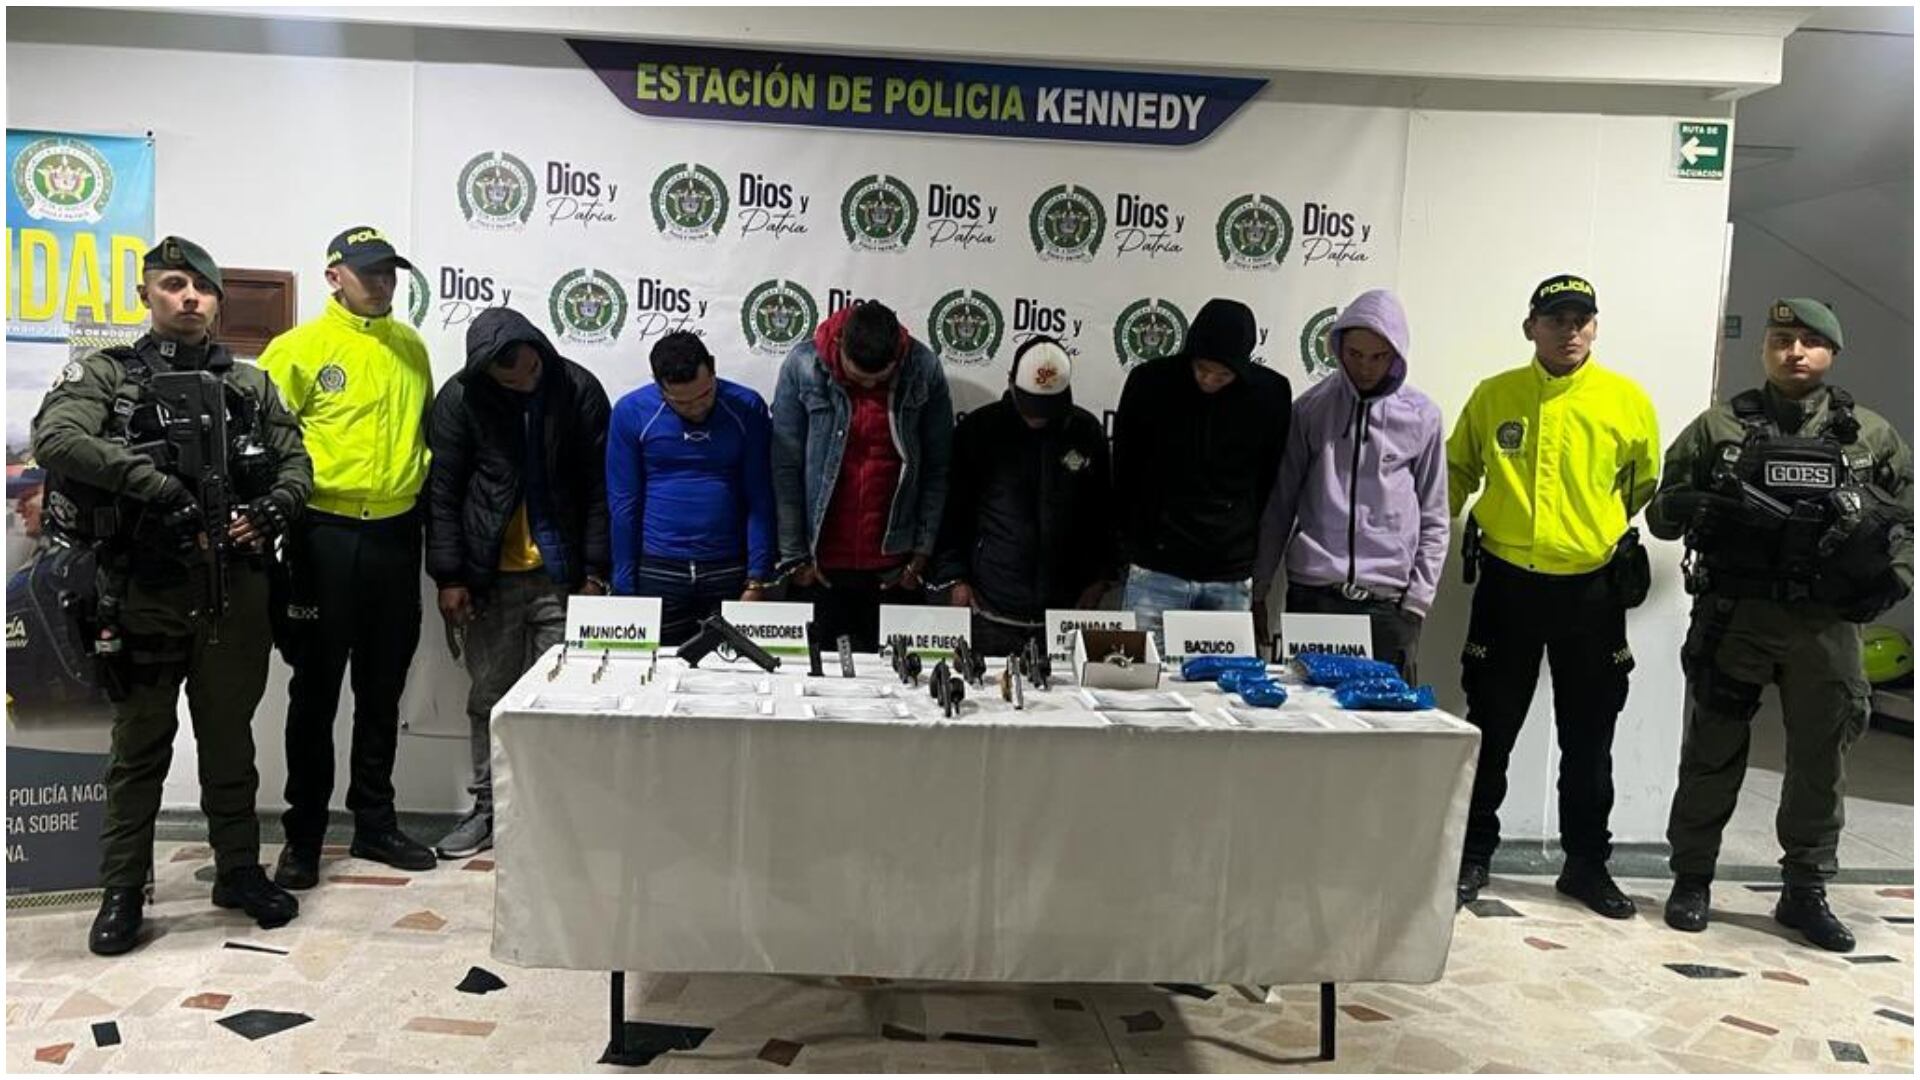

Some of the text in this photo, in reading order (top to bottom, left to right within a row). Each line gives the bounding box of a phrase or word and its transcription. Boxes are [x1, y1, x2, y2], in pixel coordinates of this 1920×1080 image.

[636, 62, 815, 110] ESTACIÓN
[827, 75, 873, 113] DE
[1036, 87, 1207, 131] KENNEDY
[1682, 125, 1704, 133] RUTA
[546, 161, 618, 202] Dios y
[739, 172, 810, 214] Dios y
[545, 196, 618, 228] Patria
[928, 184, 998, 223] Dios y
[1115, 193, 1185, 233] Dios y
[738, 208, 809, 239] Patria
[927, 219, 996, 250] Patria
[1302, 202, 1371, 242] Dios y
[1114, 228, 1183, 258] Patria
[1302, 237, 1370, 267] Patria
[440, 266, 512, 308] Dios y
[638, 278, 708, 318] Dios y
[1013, 297, 1083, 337] Dios y
[1259, 328, 1269, 346] y
[1771, 466, 1829, 484] GOES
[579, 623, 646, 640] MUNICIÓN
[916, 634, 930, 648] DE
[1184, 640, 1235, 654] BAZUCO
[9, 783, 68, 806] POLICÍA
[29, 811, 80, 834] SOBRE
